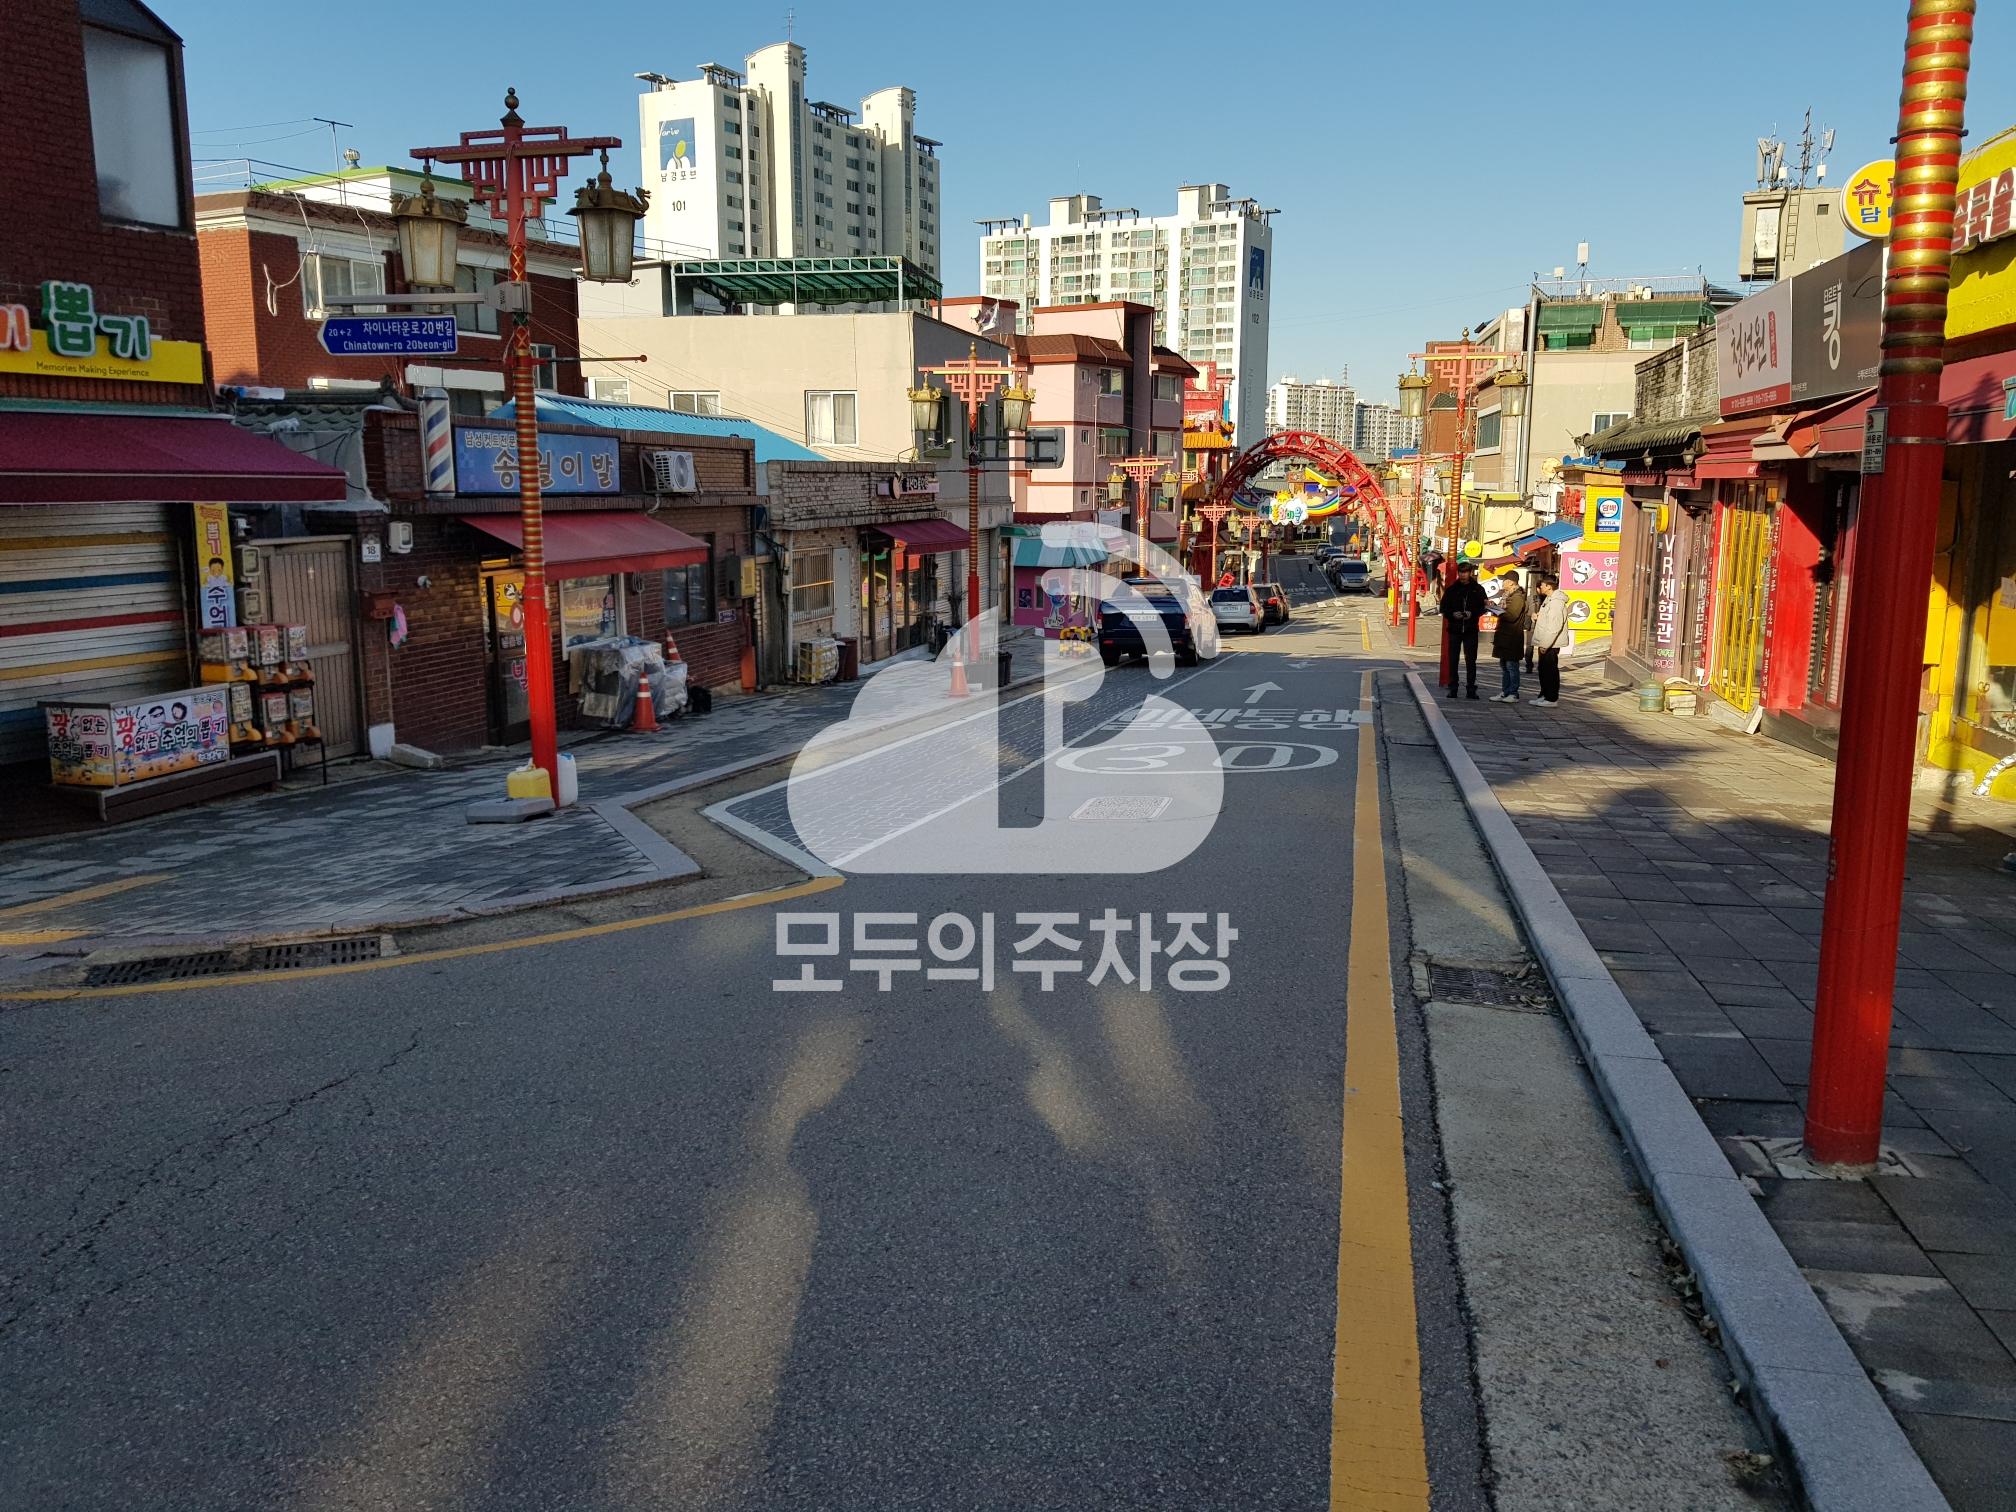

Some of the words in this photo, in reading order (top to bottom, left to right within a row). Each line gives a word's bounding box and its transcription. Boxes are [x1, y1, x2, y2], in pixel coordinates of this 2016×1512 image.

[672, 200, 686, 212] 101
[1860, 206, 1892, 224] 담
[328, 328, 338, 337] 20
[343, 340, 403, 351] Chinatown-ro
[406, 339, 454, 351] 20beon-gil
[36, 361, 77, 373] Memories
[78, 363, 108, 376] Making
[108, 366, 150, 378] Experience
[366, 545, 376, 555] 18
[1599, 570, 1618, 588] 탕
[162, 722, 198, 749] 추억의
[200, 718, 226, 741] 뽑기
